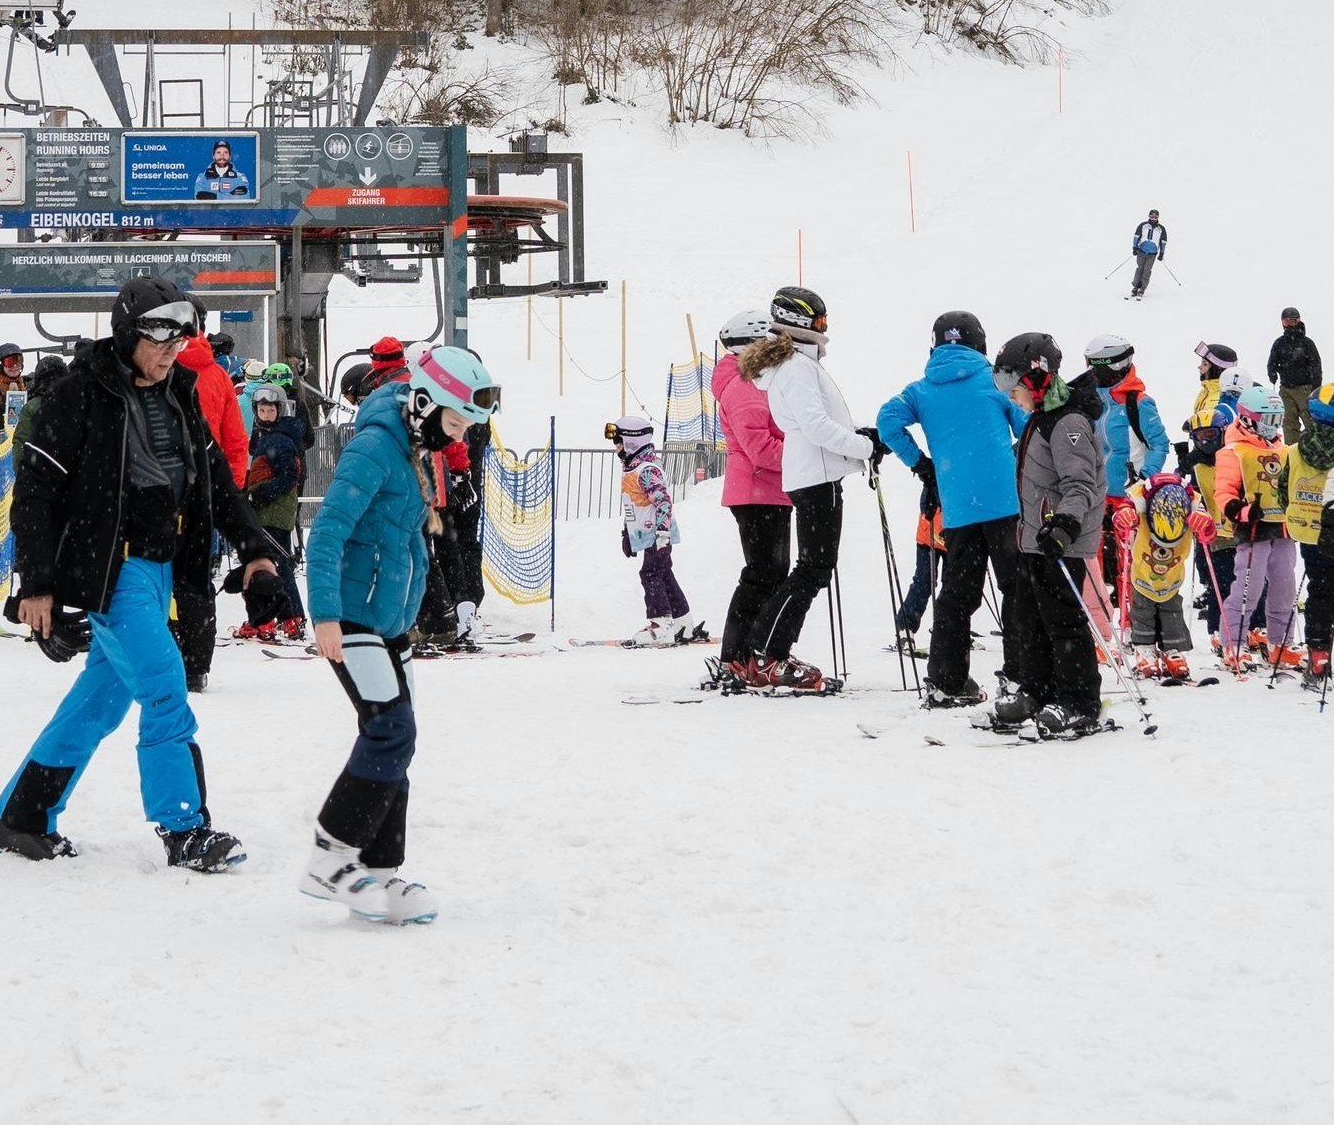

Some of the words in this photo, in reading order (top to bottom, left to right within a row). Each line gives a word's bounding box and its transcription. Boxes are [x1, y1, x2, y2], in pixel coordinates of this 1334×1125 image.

[36, 132, 110, 142] BETRIEBSZEITEN
[36, 145, 77, 155] RUNNING
[79, 145, 110, 155] HOURS
[132, 162, 185, 171] gemeinsam
[132, 172, 162, 180] besser
[163, 172, 189, 180] leben
[352, 188, 380, 196] ZUGANG
[347, 197, 386, 205] SKIFAHRER
[31, 212, 118, 227] EIBENKOGEL
[122, 216, 141, 226] 812
[144, 218, 154, 226] m
[12, 255, 53, 265] HERZLICH
[55, 254, 112, 264] WILLKOMMEN
[114, 254, 123, 264] IN
[125, 254, 173, 263] LACKENHOF
[175, 254, 189, 263] AM
[191, 253, 231, 263] ÖTSCHER!
[1296, 492, 1323, 502] LACKE
